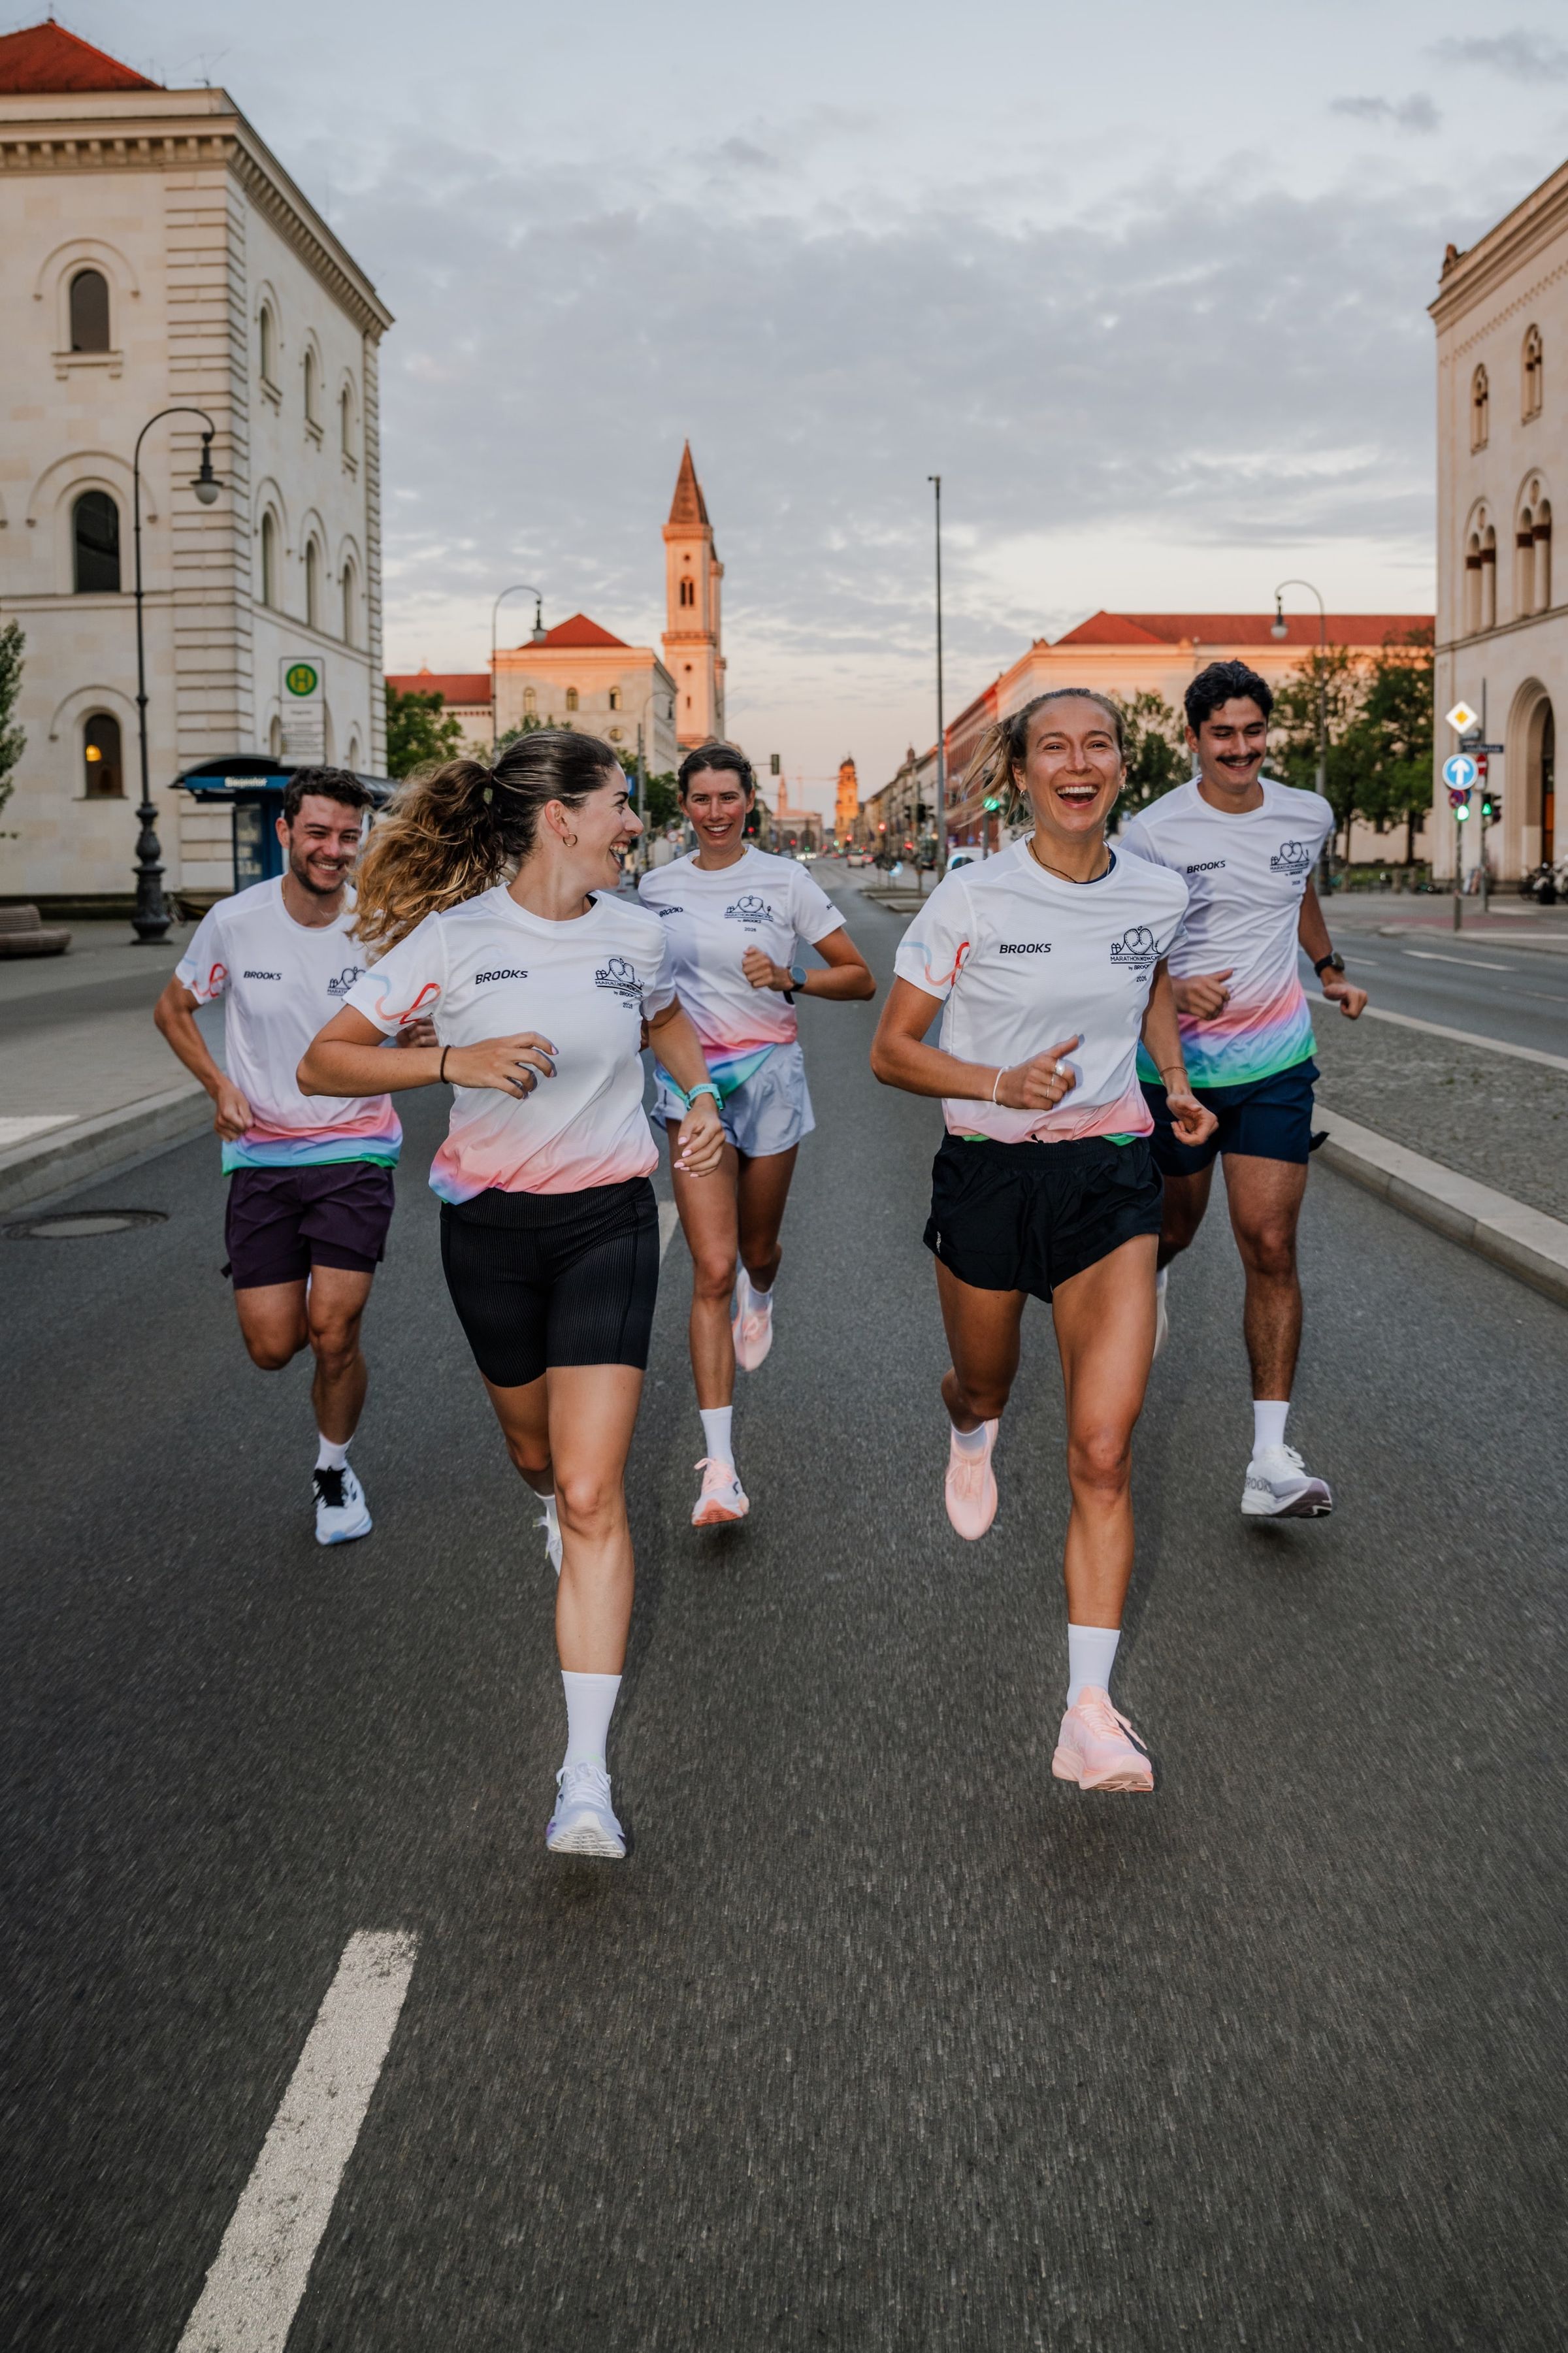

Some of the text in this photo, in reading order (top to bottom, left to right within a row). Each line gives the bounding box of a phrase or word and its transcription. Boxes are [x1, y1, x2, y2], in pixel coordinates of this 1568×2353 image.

[1186, 860, 1226, 874] BROOKS
[659, 906, 683, 917] BROOKS
[999, 943, 1052, 953] BROOKS
[244, 971, 282, 981] BROOKS
[475, 969, 529, 985] BROOKS
